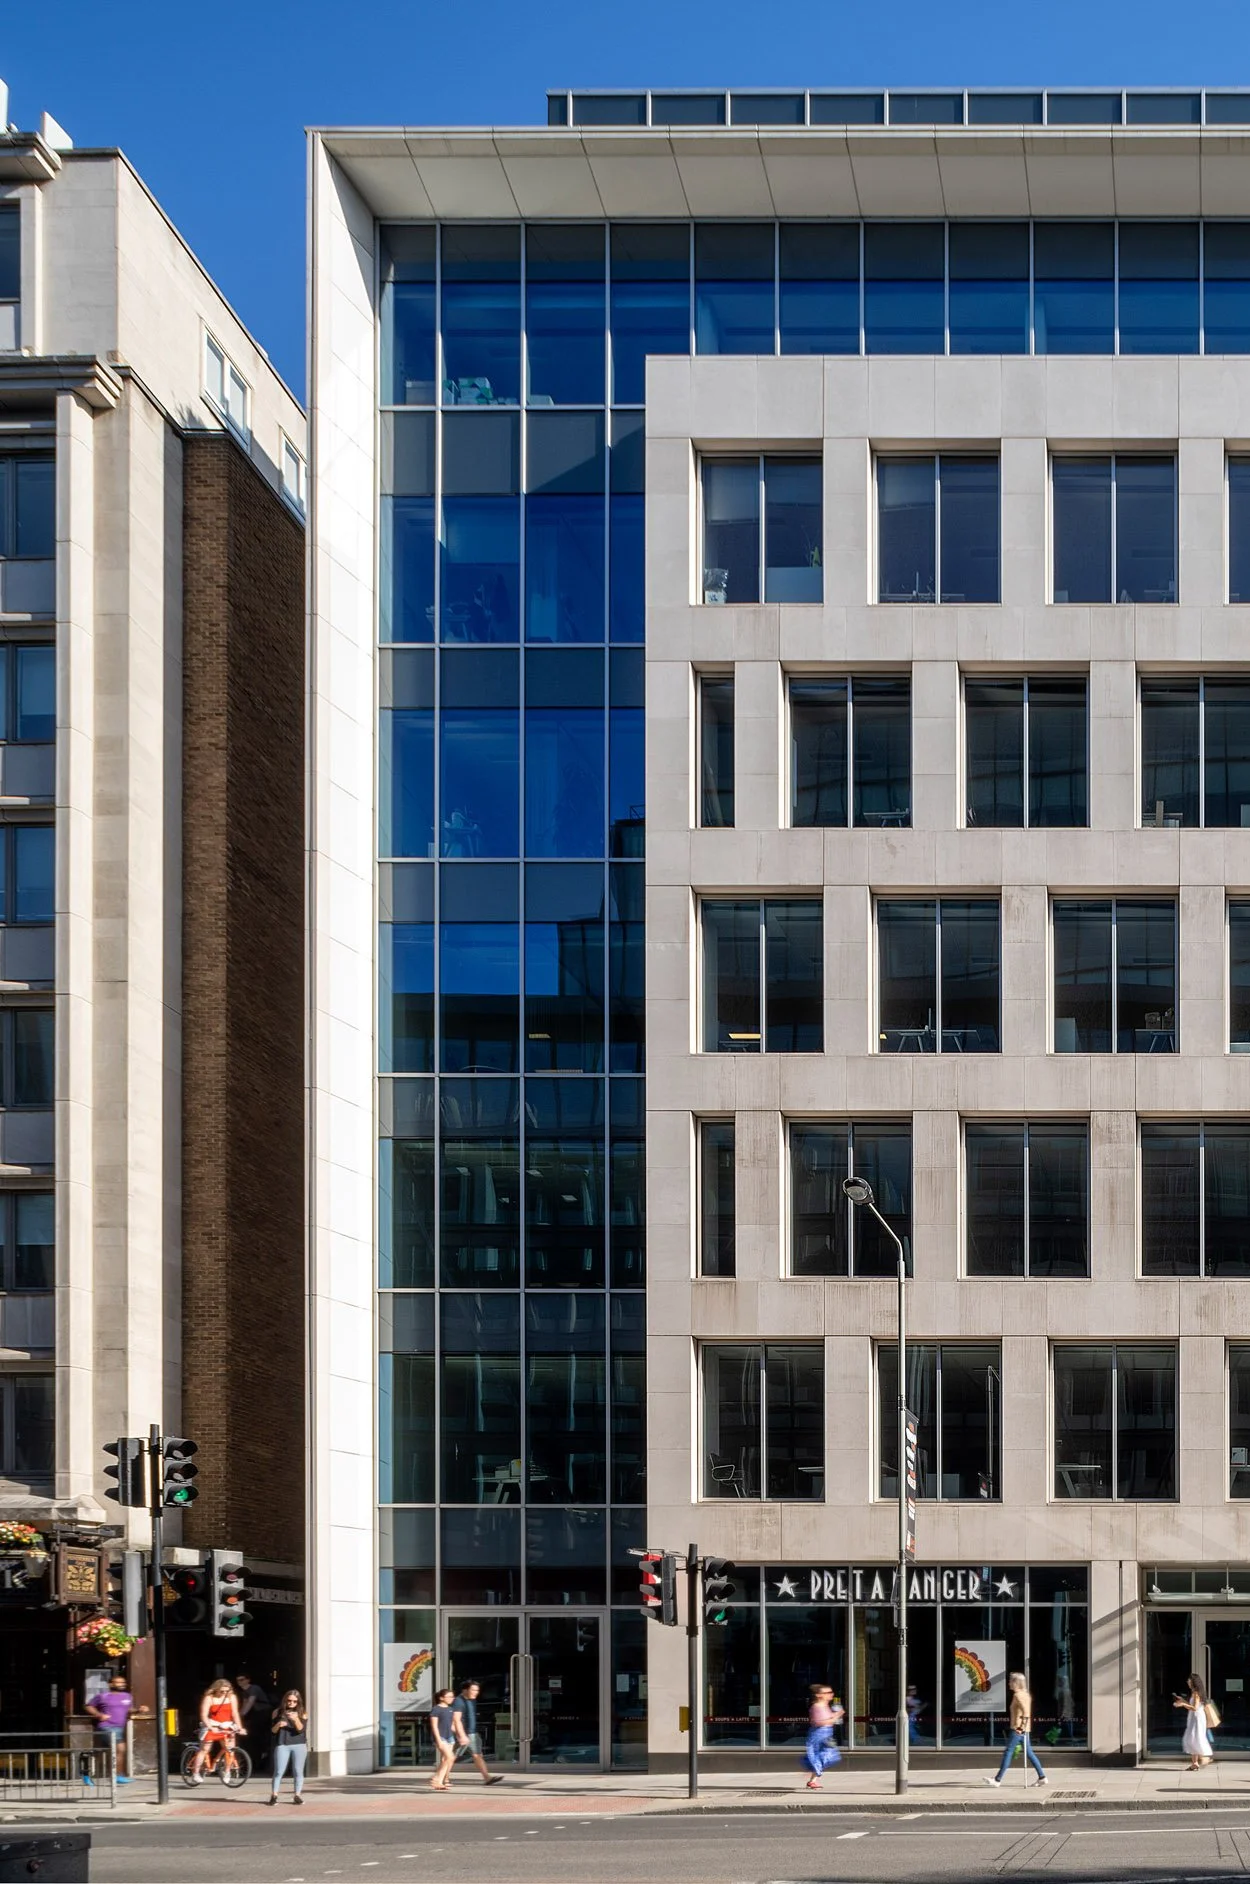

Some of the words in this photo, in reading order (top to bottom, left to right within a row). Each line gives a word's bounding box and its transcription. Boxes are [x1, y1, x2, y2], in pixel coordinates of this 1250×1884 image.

[810, 1569, 864, 1600] PRET
[871, 1570, 885, 1600] A
[892, 1569, 982, 1600] ANGER
